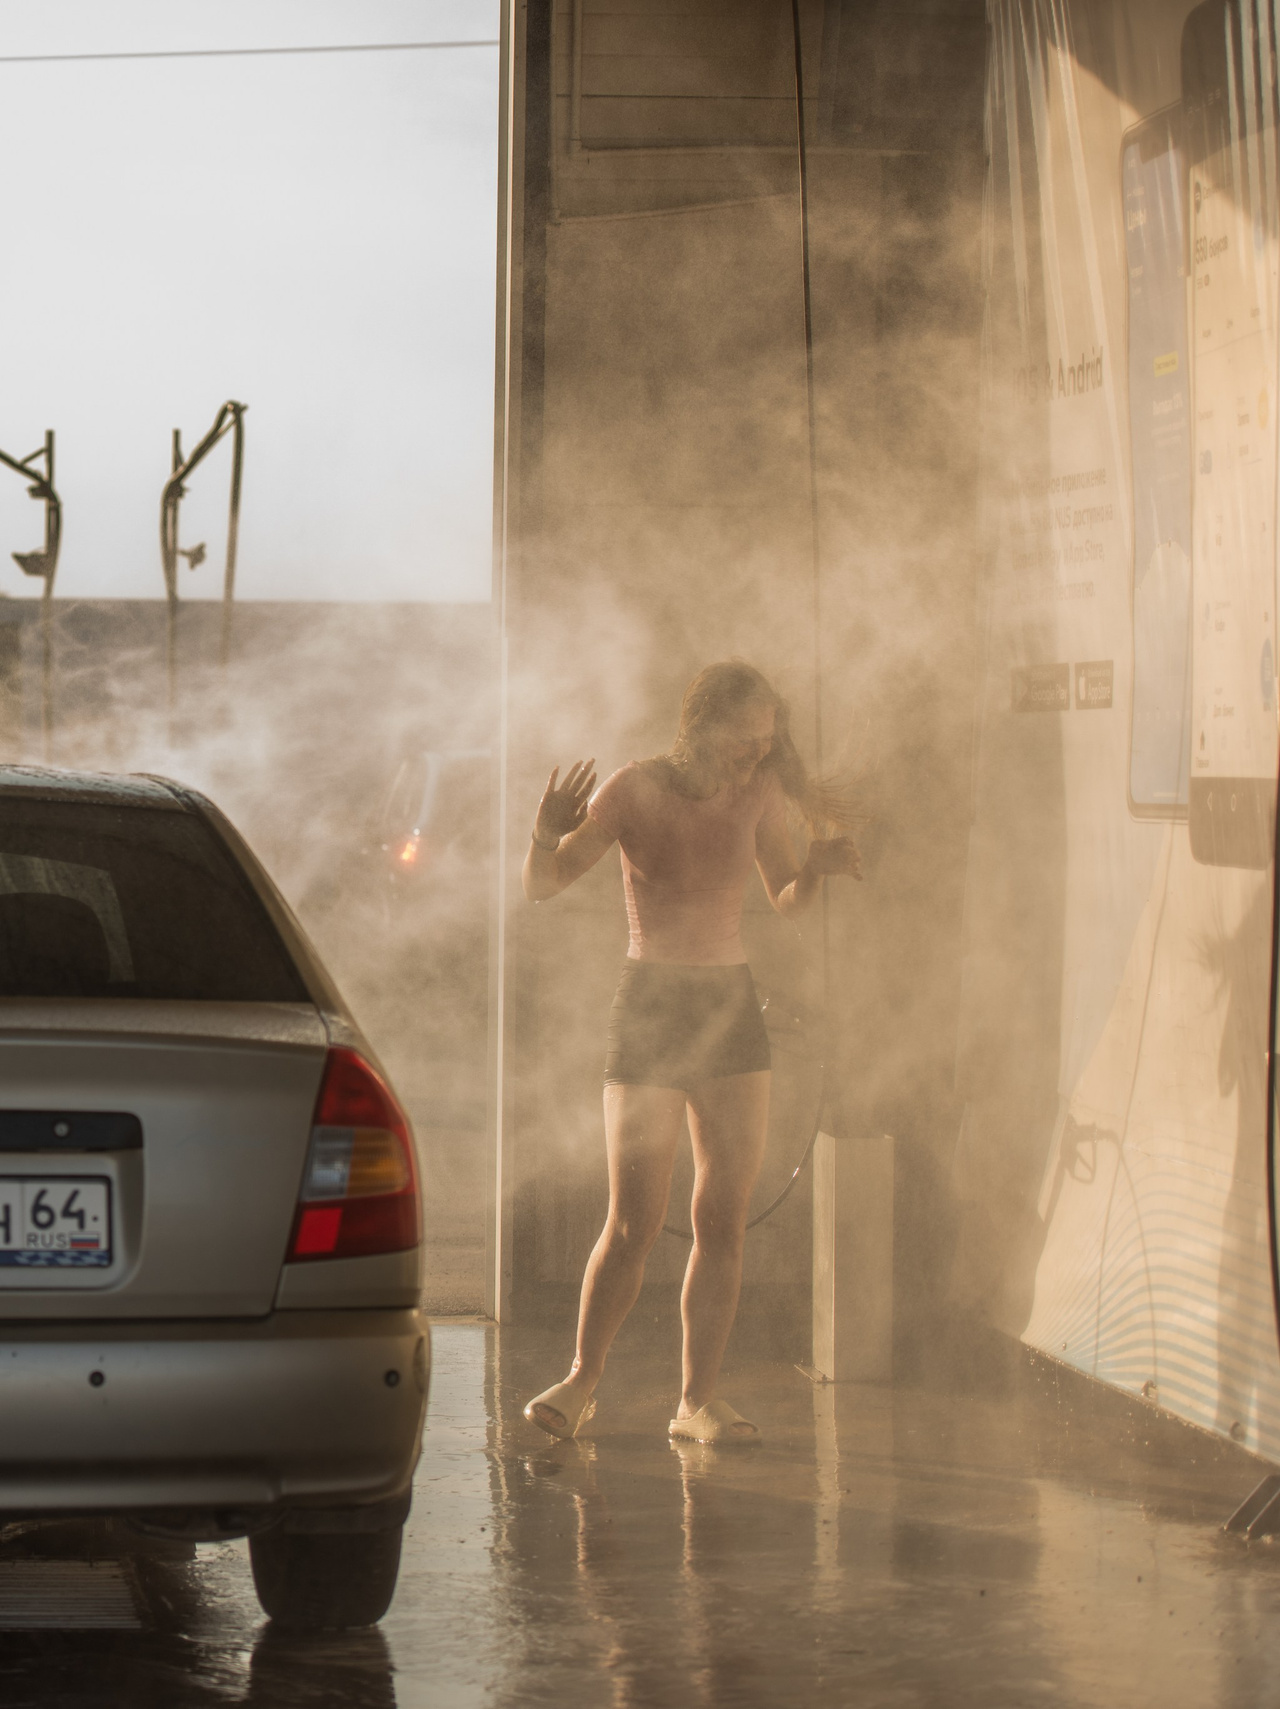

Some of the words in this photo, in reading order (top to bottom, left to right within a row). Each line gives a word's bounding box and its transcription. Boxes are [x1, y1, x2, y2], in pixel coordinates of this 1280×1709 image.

[1195, 235, 1207, 265] 550
[1044, 359, 1054, 401] &
[1061, 465, 1106, 496] приложение
[1084, 535, 1104, 562] Store,
[1030, 684, 1054, 705] Google
[1055, 683, 1067, 704] Play
[1087, 682, 1097, 704] App
[1098, 682, 1110, 698] Store
[30, 1189, 86, 1231] 64
[26, 1233, 67, 1248] RUS
